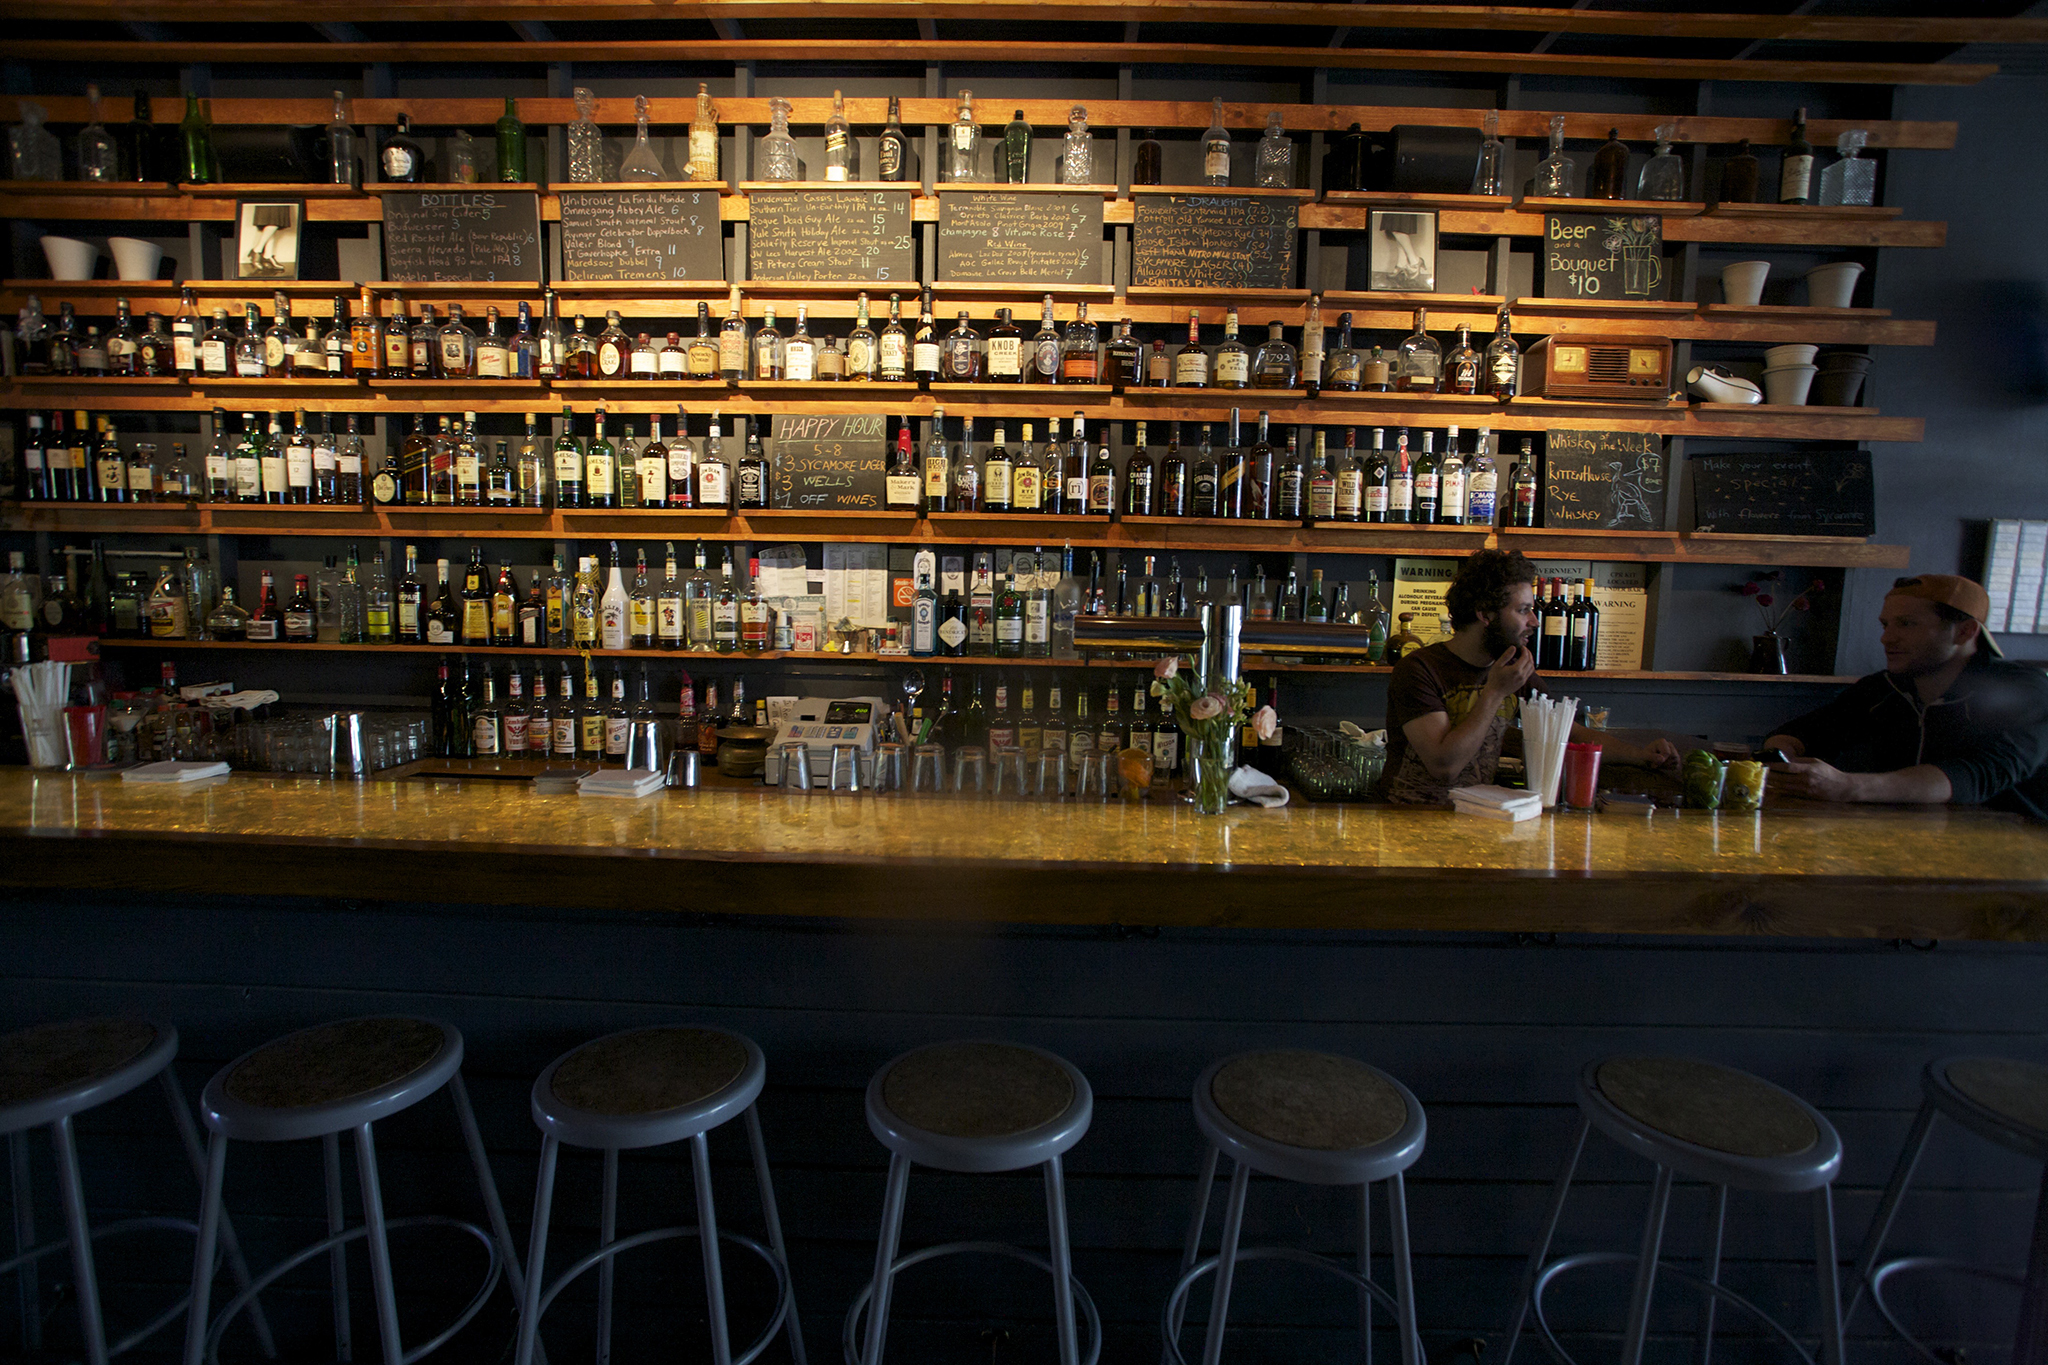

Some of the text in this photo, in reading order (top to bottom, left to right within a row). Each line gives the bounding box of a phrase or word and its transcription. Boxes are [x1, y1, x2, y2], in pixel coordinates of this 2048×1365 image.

[421, 194, 496, 208] BOTTLES
[562, 192, 700, 206] Unibroue Monde 8
[751, 192, 886, 204] Lindemans Cassis 12
[972, 194, 998, 202] White
[1186, 196, 1250, 206] DRAUGHT
[563, 204, 679, 218] Ommegang Abbey Ale 6
[852, 202, 904, 214] IPA 14
[1071, 203, 1080, 214] 6
[1230, 207, 1245, 215] IPA
[452, 219, 460, 230] 3
[563, 215, 698, 228] Samuel Smith Stout 8
[750, 213, 885, 228] Rogue Dead Guy Ale 15
[1079, 214, 1087, 224] 7
[1176, 215, 1296, 228] Old 6
[697, 225, 704, 236] 8
[750, 225, 886, 239] Yule Smith Ale 21
[1042, 222, 1078, 231] 2009 7
[1134, 226, 1154, 236] Six
[1155, 226, 1190, 236] Point
[1550, 218, 1596, 240] Beer
[940, 228, 987, 238] Champagne
[992, 226, 999, 237] 8
[1067, 232, 1076, 241] 7
[598, 238, 634, 248] Blond 9
[791, 236, 910, 250] Reserve 25
[987, 239, 1026, 248] Red Wine
[1134, 238, 1238, 248] Goose Honkers
[635, 244, 676, 256] Extra 11
[818, 247, 832, 256] Ale
[834, 248, 861, 256] 2002
[866, 246, 880, 255] 20
[1081, 248, 1090, 260] 6
[1188, 249, 1212, 258] NITRO
[513, 256, 521, 266] 8
[618, 256, 662, 270] Dubbel 9
[767, 256, 870, 269] Peters Cream Stout 11
[1080, 260, 1088, 270] 7
[1135, 256, 1290, 273] SYCAMORE LAGER 4
[1550, 252, 1619, 278] Bouquet
[568, 266, 686, 280] Delirium Tremens 10
[786, 267, 890, 281] Valley Porter 15
[1040, 268, 1074, 280] Merlot 7
[1136, 266, 1225, 280] Allagash White
[1134, 277, 1190, 287] LAGUNITAS
[1568, 272, 1600, 295] $10
[992, 340, 1014, 350] KNOB
[1266, 354, 1290, 362] 1792
[780, 416, 884, 439] HAPPY HOUR
[1549, 432, 1652, 454] Whiskey of the Week
[796, 458, 858, 472] SYCAMORE
[860, 459, 886, 472] LAGER
[1642, 458, 1660, 472] $7
[1703, 460, 1812, 472] Make your event
[804, 476, 854, 488] WELLS
[1730, 475, 1801, 492] Special
[800, 494, 828, 504] OFF
[837, 494, 877, 507] WINES
[1738, 508, 1780, 520] flowers
[1401, 567, 1452, 578] WARNING
[1594, 600, 1636, 608] WARNING
